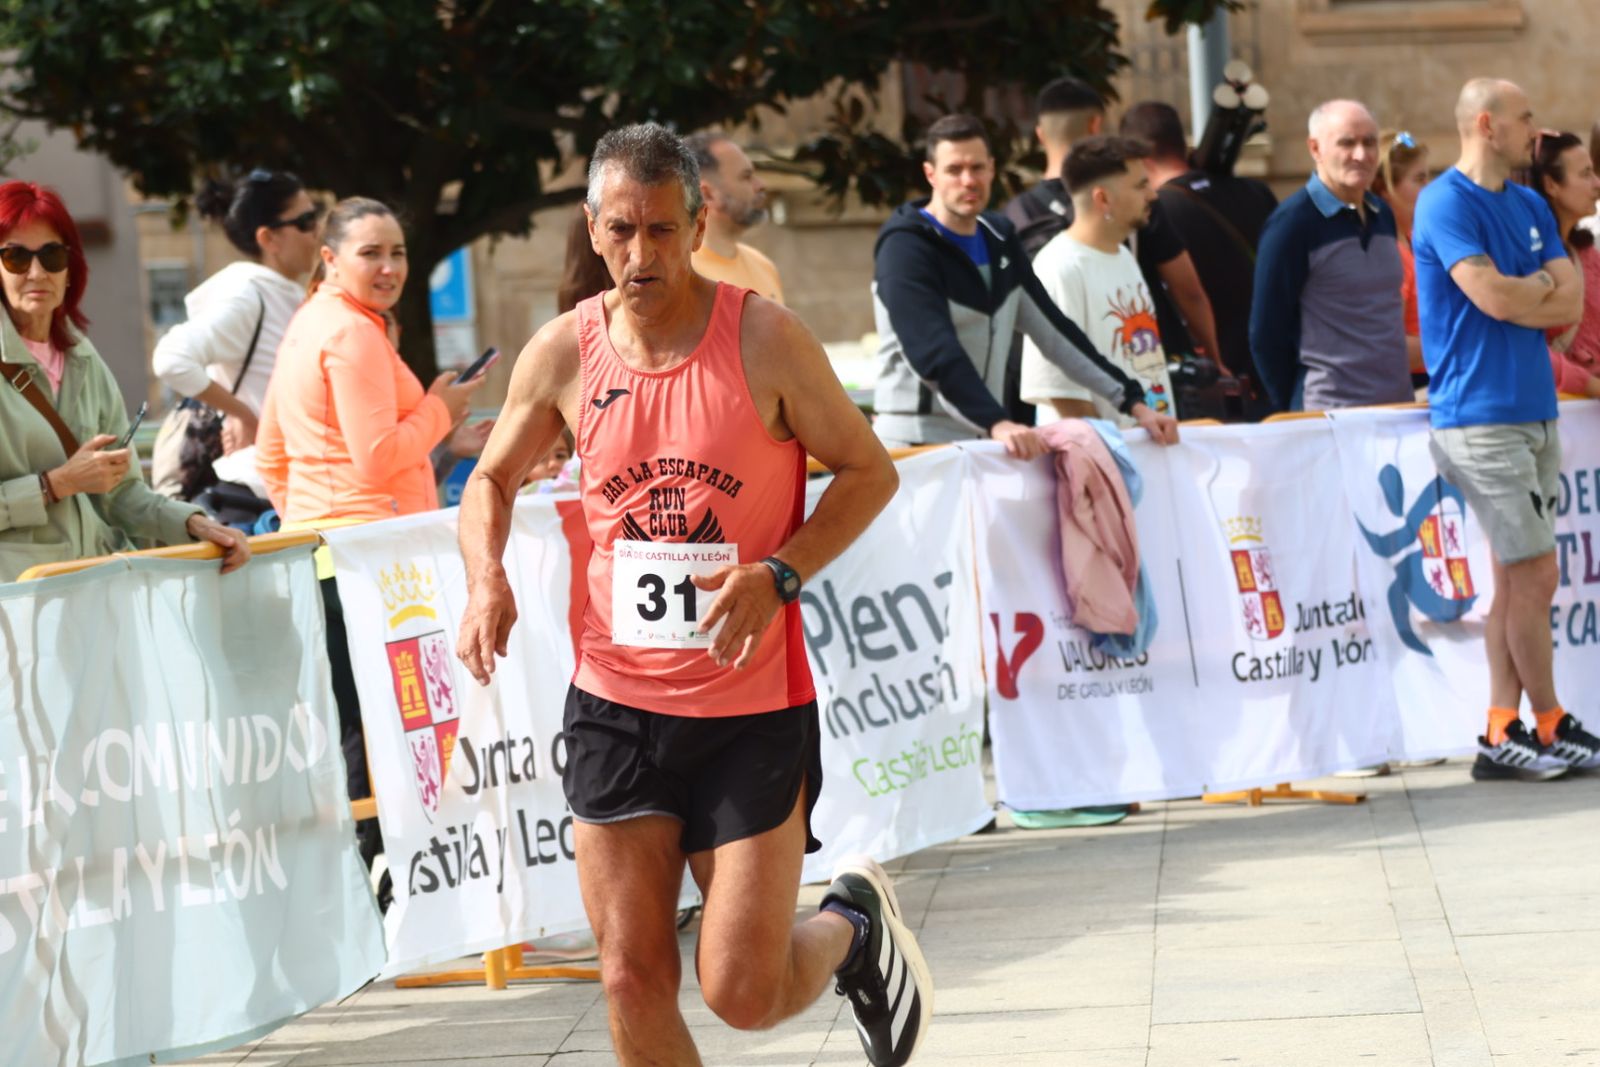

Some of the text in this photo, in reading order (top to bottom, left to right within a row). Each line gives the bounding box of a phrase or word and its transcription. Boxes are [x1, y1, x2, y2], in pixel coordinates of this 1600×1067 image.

[602, 457, 744, 505] BAR LA ESCAPADA
[648, 487, 686, 511] RUN
[649, 513, 689, 537] CLUB
[645, 551, 690, 561] CASTILLA
[692, 553, 699, 561] Y
[701, 551, 731, 562] LEÓN
[636, 573, 697, 622] 31
[1308, 648, 1322, 683] y
